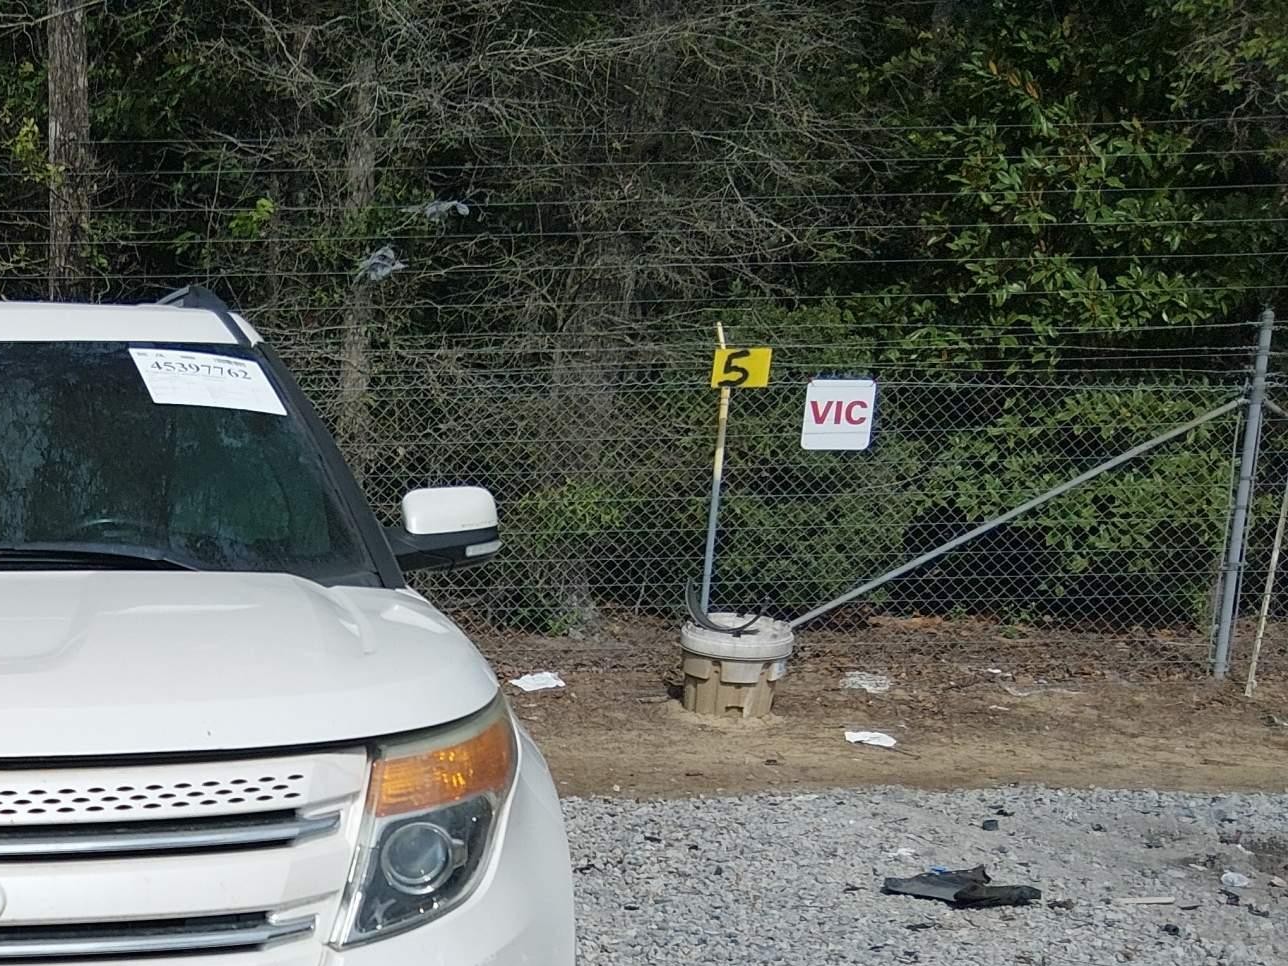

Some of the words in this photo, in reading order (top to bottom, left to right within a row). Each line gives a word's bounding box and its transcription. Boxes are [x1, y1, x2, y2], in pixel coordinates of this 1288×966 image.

[151, 360, 251, 380] 45397762
[718, 350, 750, 387] 5
[810, 400, 868, 425] VIC
